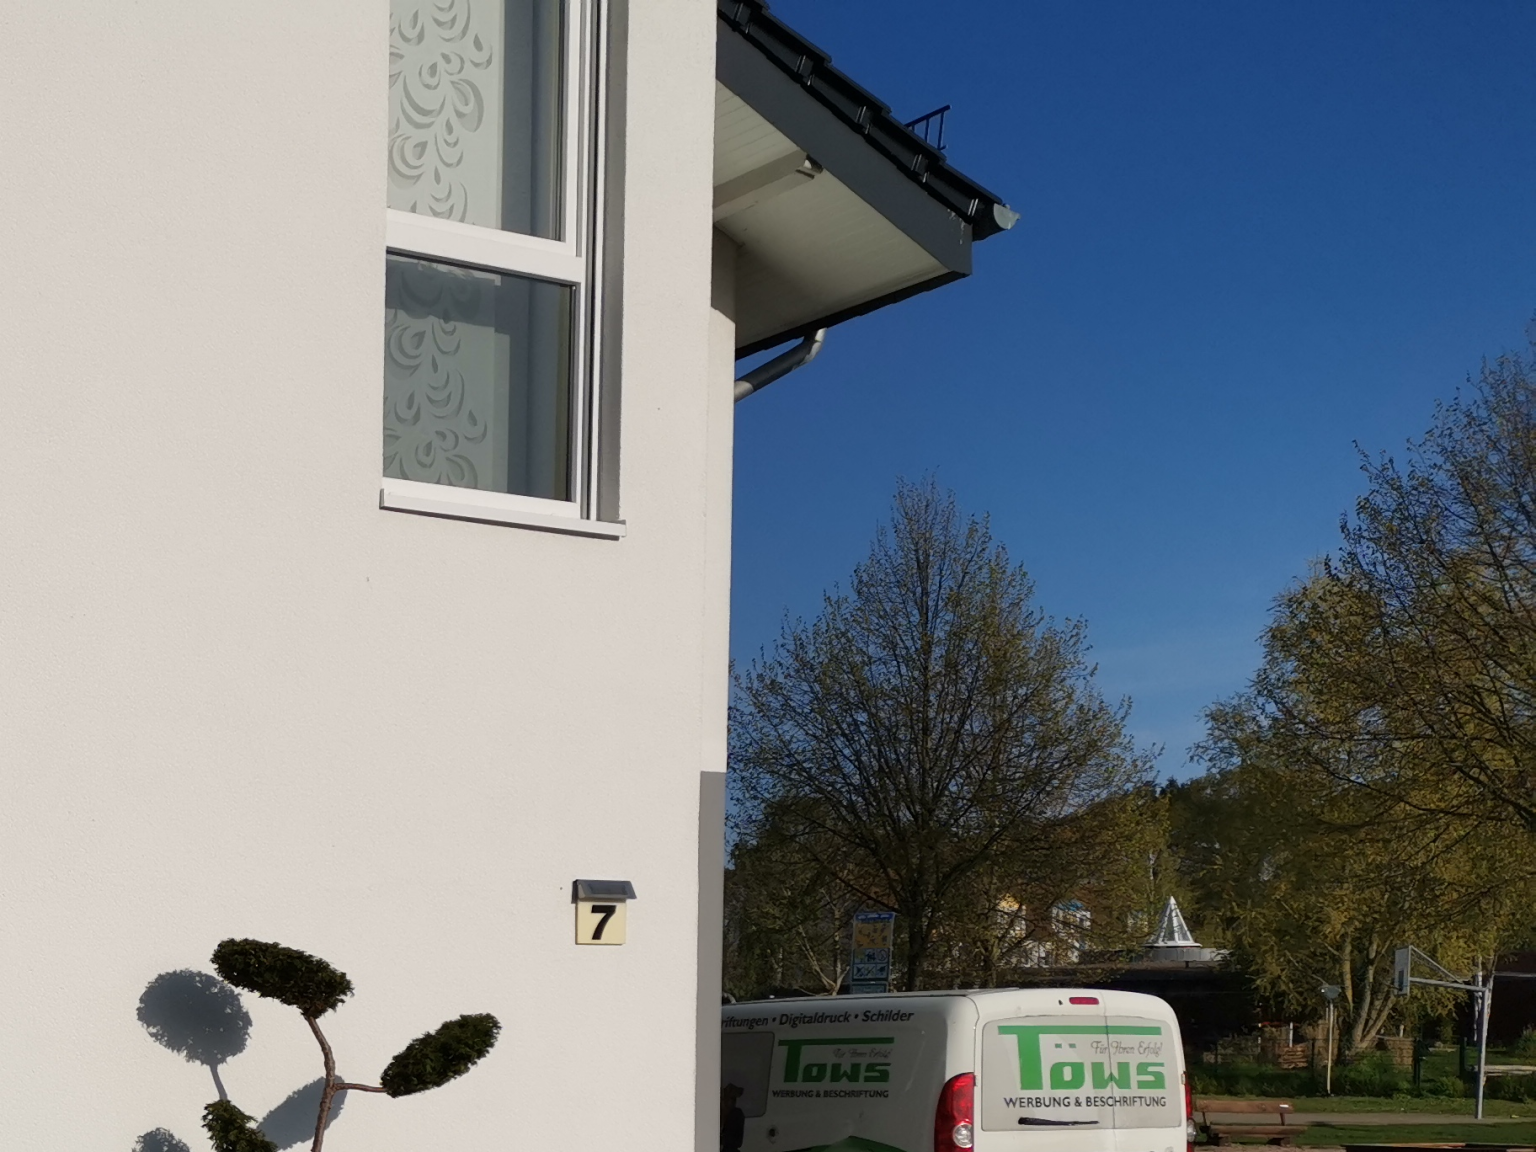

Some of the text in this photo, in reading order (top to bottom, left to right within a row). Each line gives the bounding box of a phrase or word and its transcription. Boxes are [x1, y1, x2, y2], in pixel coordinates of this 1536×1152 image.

[590, 904, 617, 941] 7
[779, 1011, 851, 1029] Digitaldruck
[861, 1010, 915, 1023] Schilder
[772, 1089, 814, 1099] WERBUNG
[823, 1089, 889, 1099] BESCHRIFTUNG
[1003, 1095, 1167, 1108] WERBUNG & BESCHRIFTUNG
